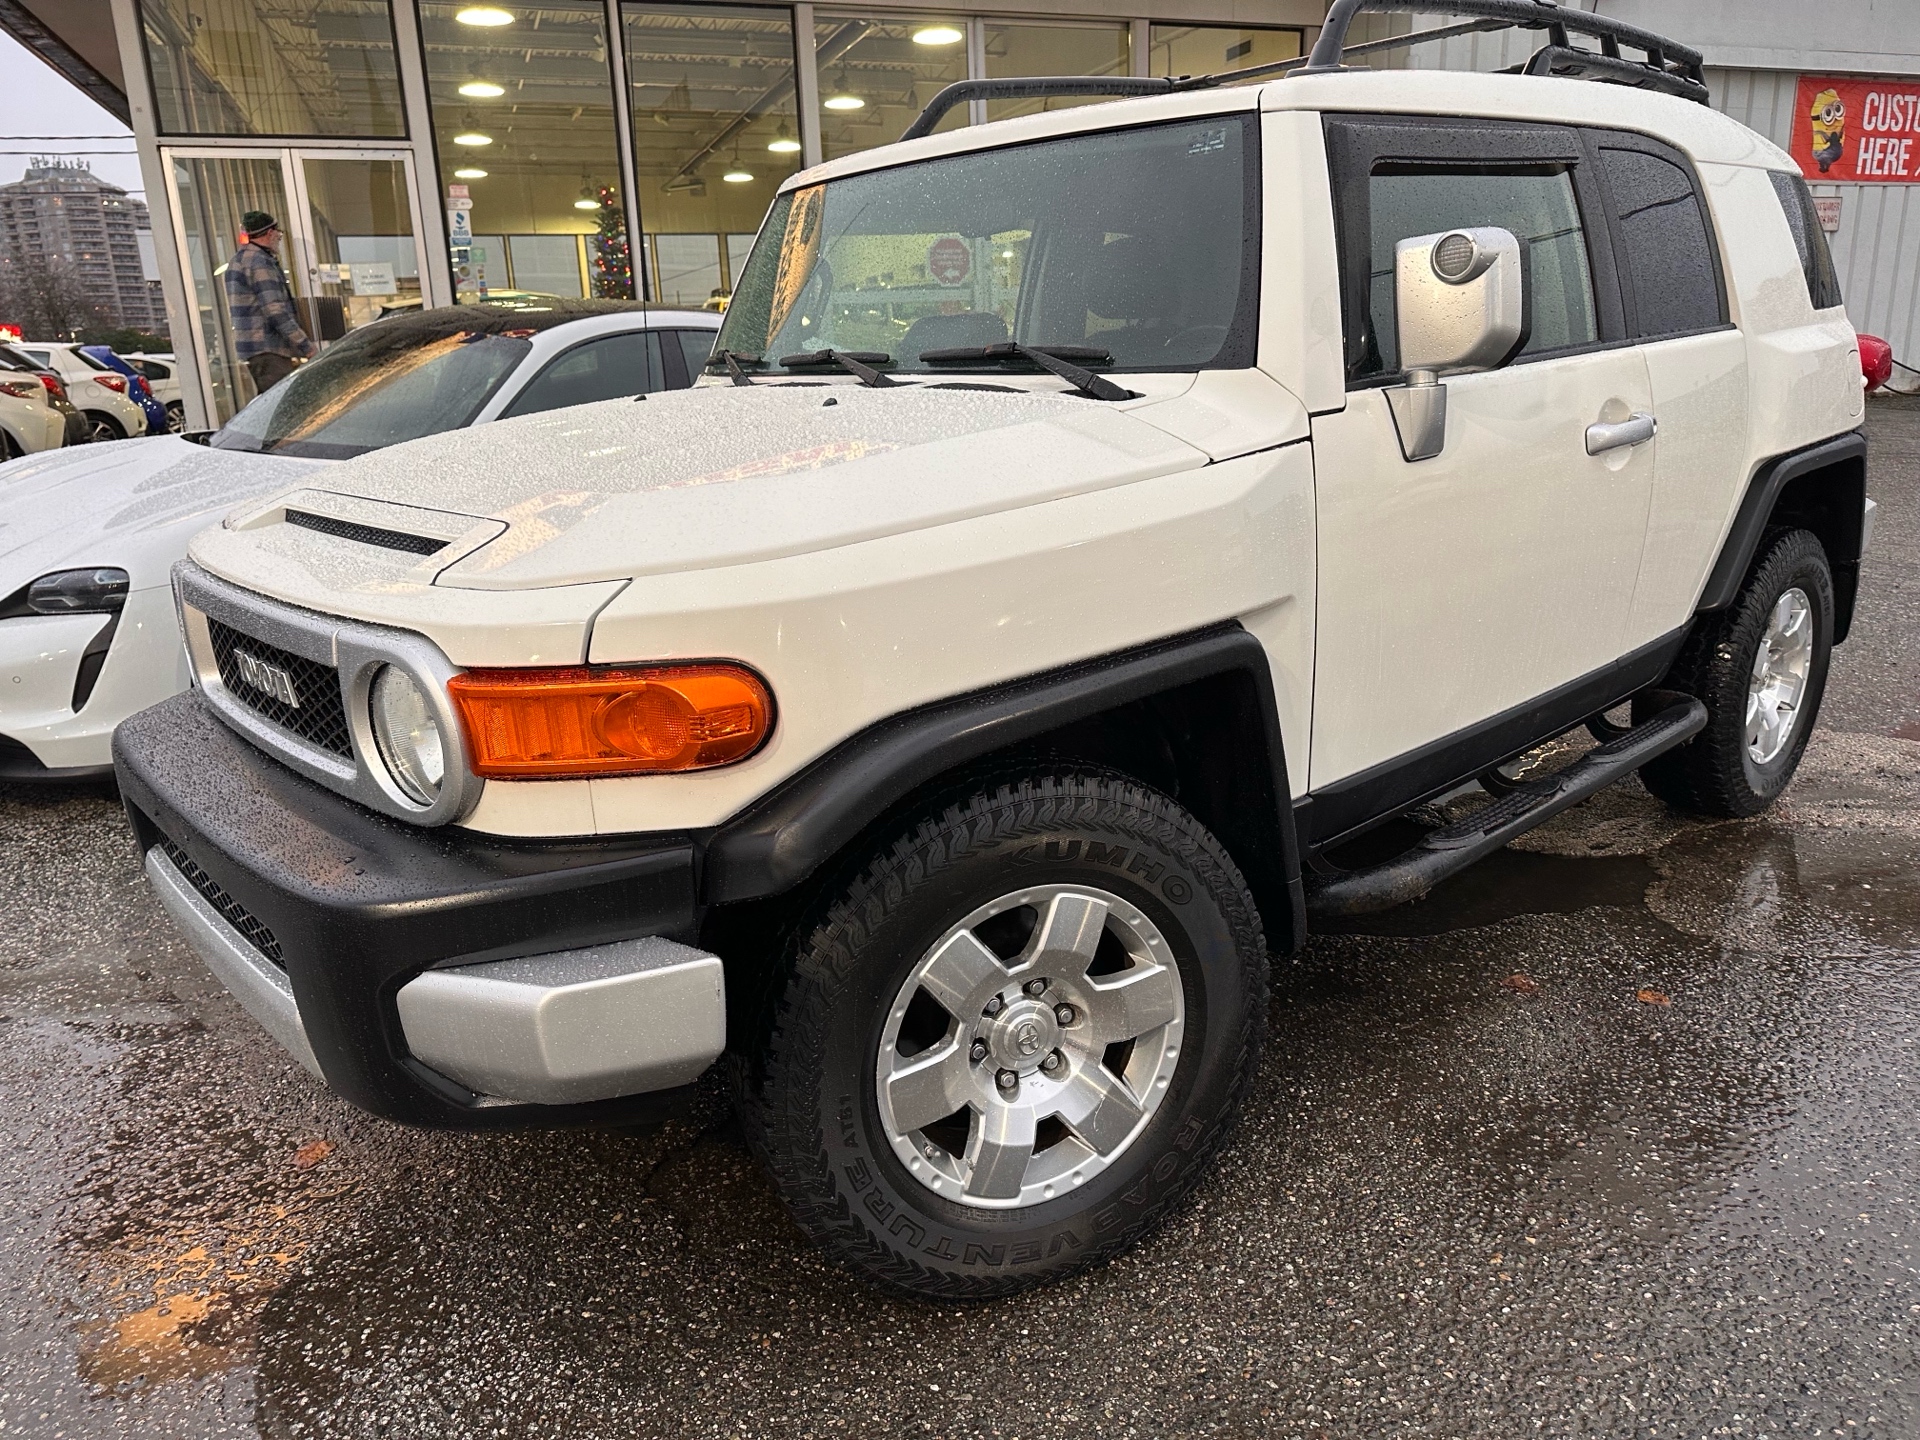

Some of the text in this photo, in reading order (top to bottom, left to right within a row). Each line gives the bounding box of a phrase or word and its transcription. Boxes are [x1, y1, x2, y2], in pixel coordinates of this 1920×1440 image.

[1856, 137, 1913, 176] HERE
[233, 647, 300, 708] TOYOTA
[999, 840, 1193, 905] KUMHO
[1091, 1115, 1205, 1234] ROAD
[844, 1157, 1082, 1266] VENTURE
